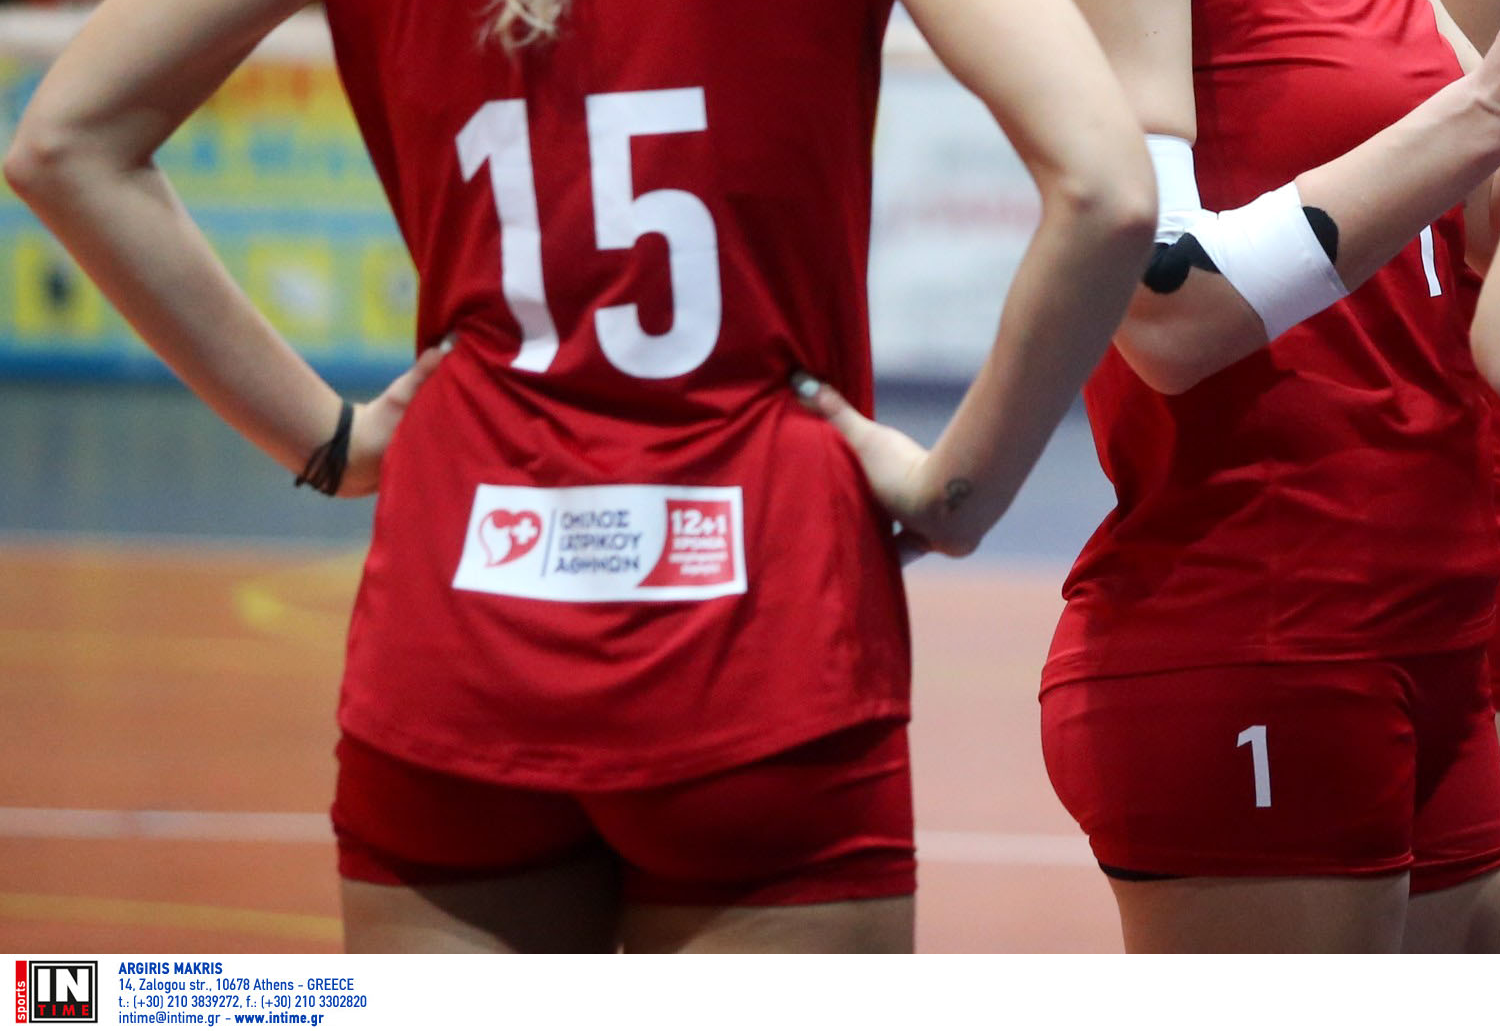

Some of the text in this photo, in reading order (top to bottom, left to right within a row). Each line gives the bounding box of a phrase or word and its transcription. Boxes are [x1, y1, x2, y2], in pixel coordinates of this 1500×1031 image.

[455, 86, 723, 380] 15
[671, 508, 728, 536] 12+1
[1237, 725, 1271, 807] 1
